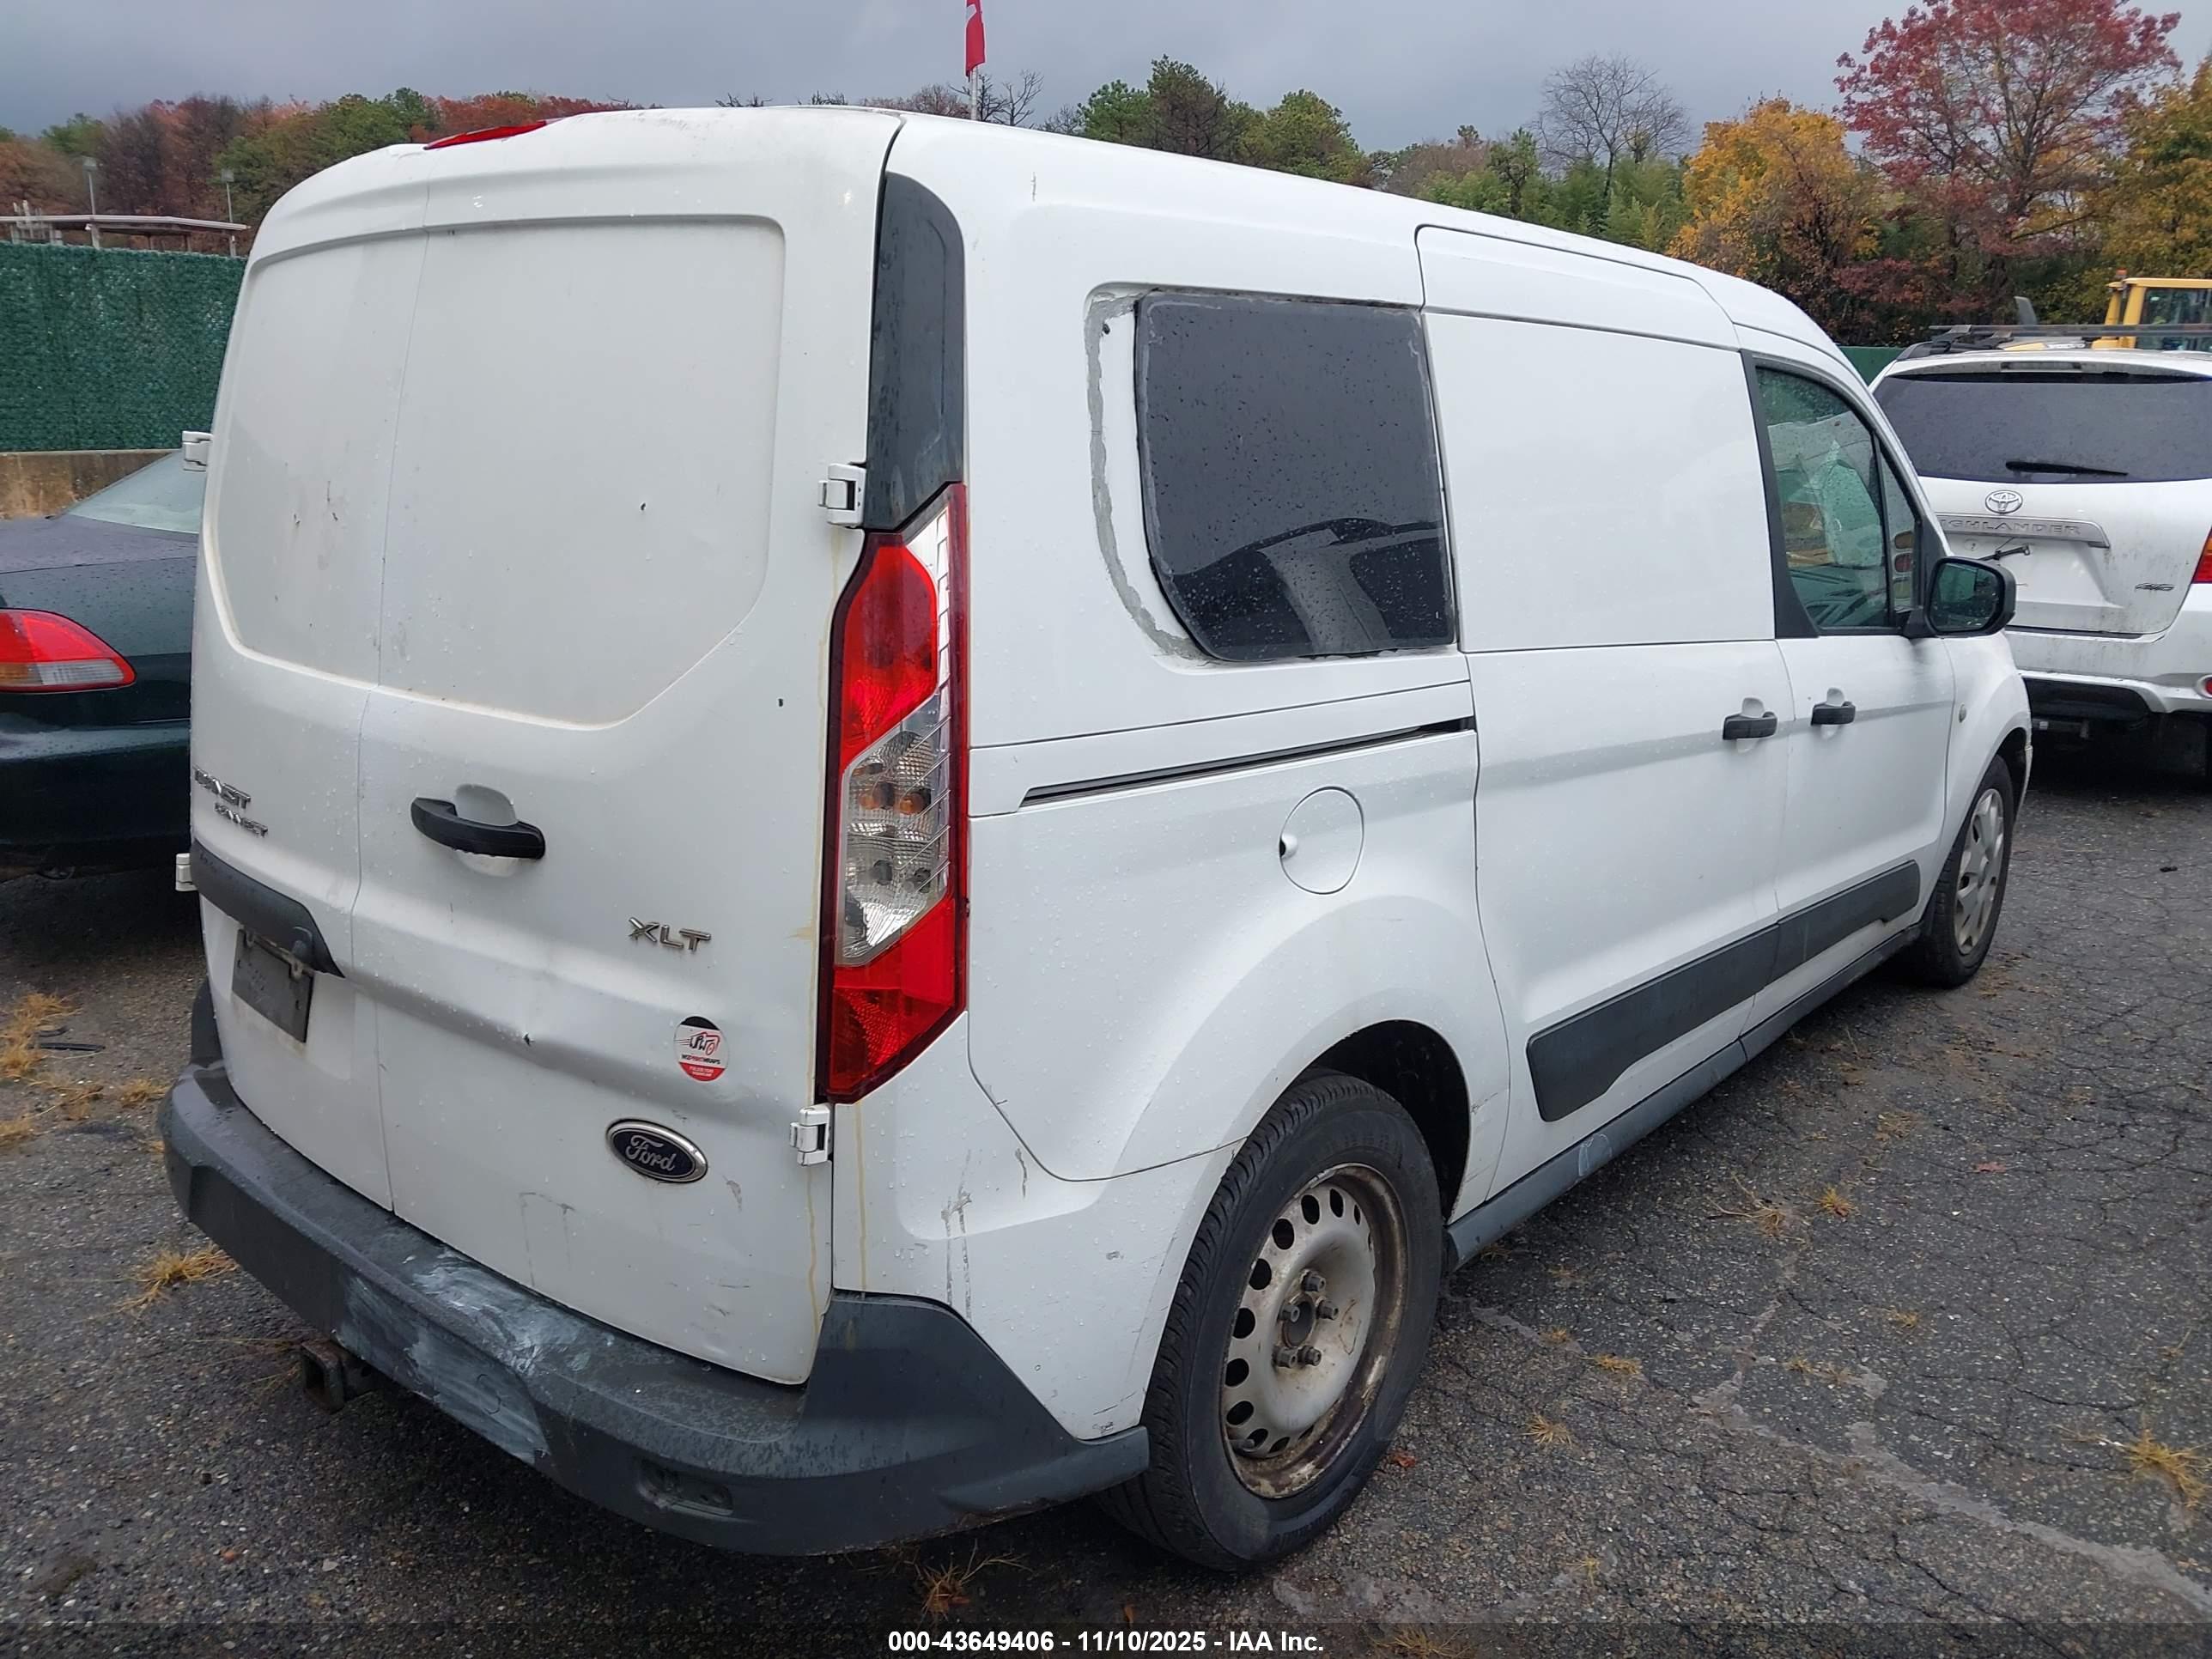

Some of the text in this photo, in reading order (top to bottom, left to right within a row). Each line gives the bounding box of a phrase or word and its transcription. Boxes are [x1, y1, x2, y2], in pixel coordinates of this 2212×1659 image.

[1940, 518, 2081, 536] IGHLANDER
[629, 916, 712, 952] XLT
[625, 1134, 677, 1171] Ford
